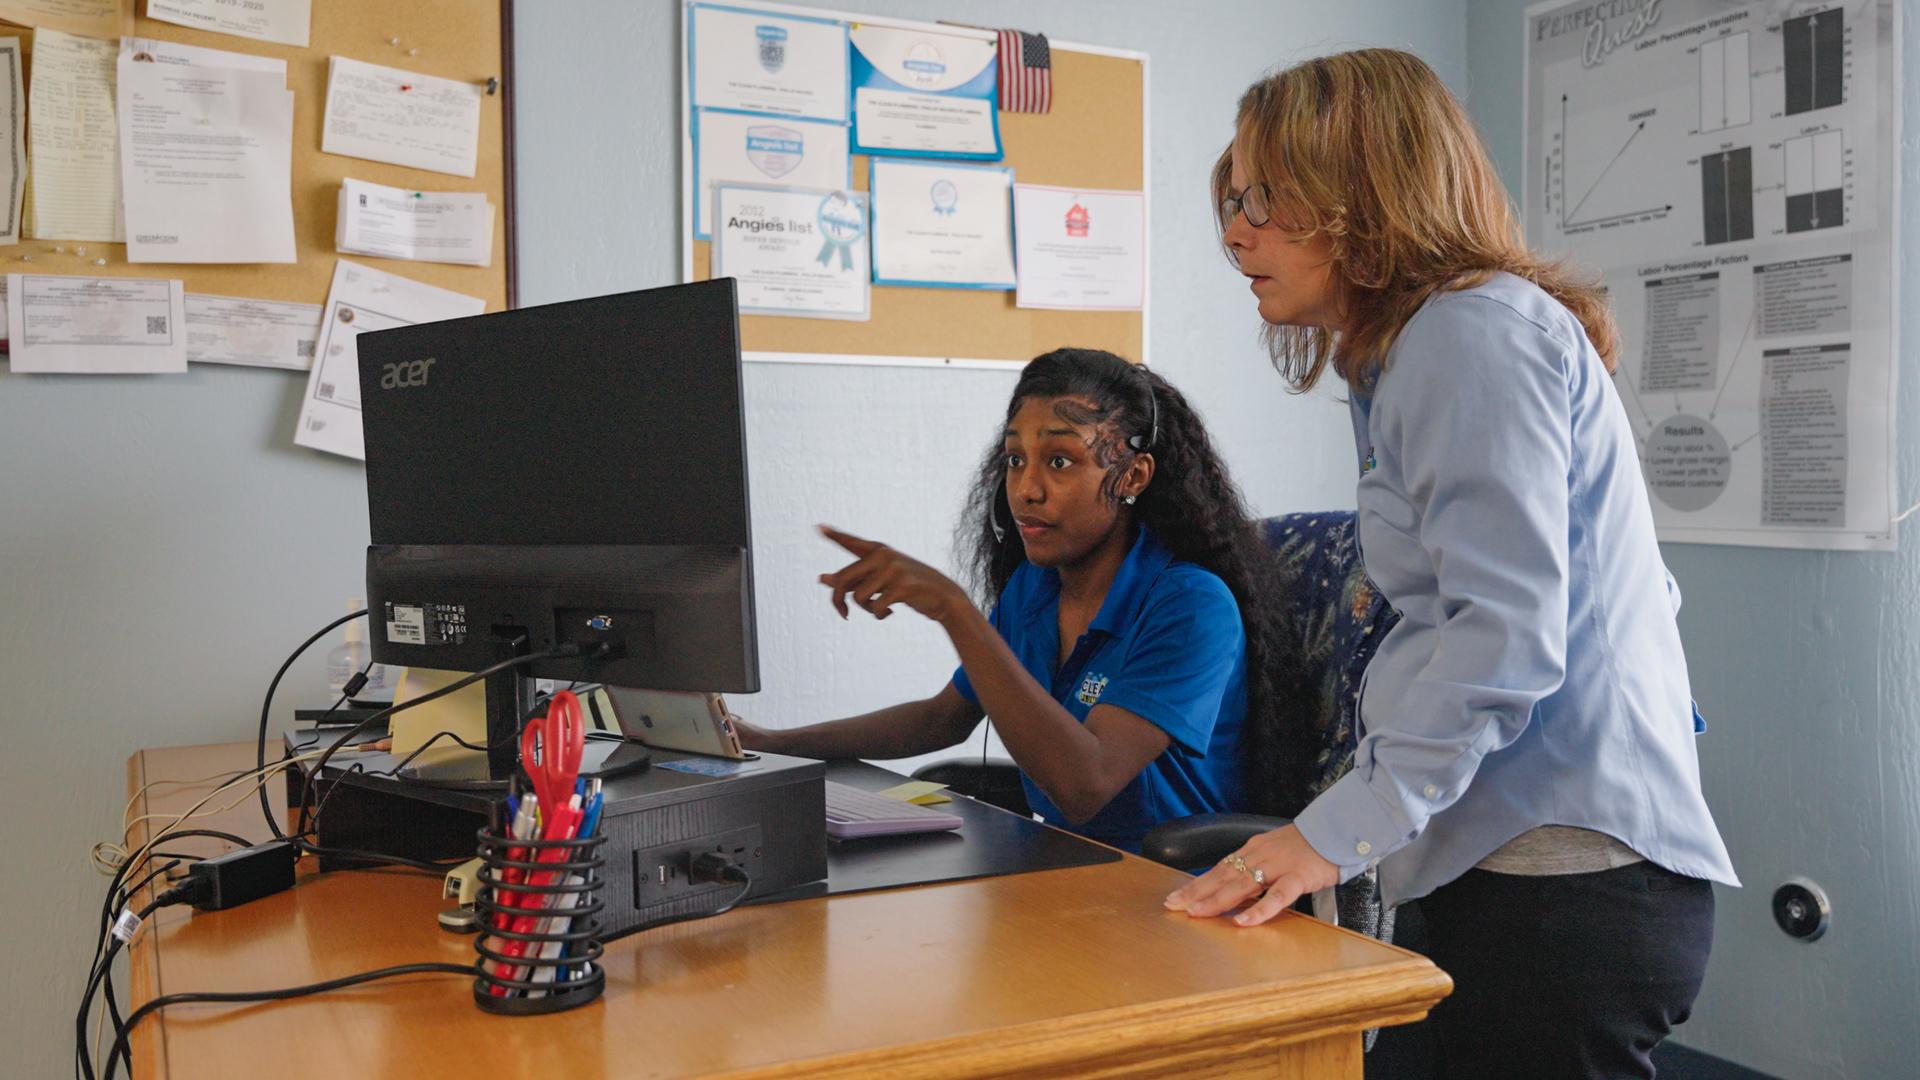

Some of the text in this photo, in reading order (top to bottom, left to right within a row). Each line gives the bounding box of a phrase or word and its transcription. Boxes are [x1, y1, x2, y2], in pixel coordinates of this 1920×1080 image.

[1582, 0, 1662, 68] Quest
[1634, 10, 1749, 51] Labor Percentage Variables
[739, 204, 766, 217] 2012
[788, 219, 814, 234] list
[1638, 254, 1749, 276] Labor Percentage Factors
[380, 357, 437, 390] acer
[1664, 426, 1704, 436] Results
[1651, 456, 1674, 464] Lower
[1662, 468, 1685, 477] Lower
